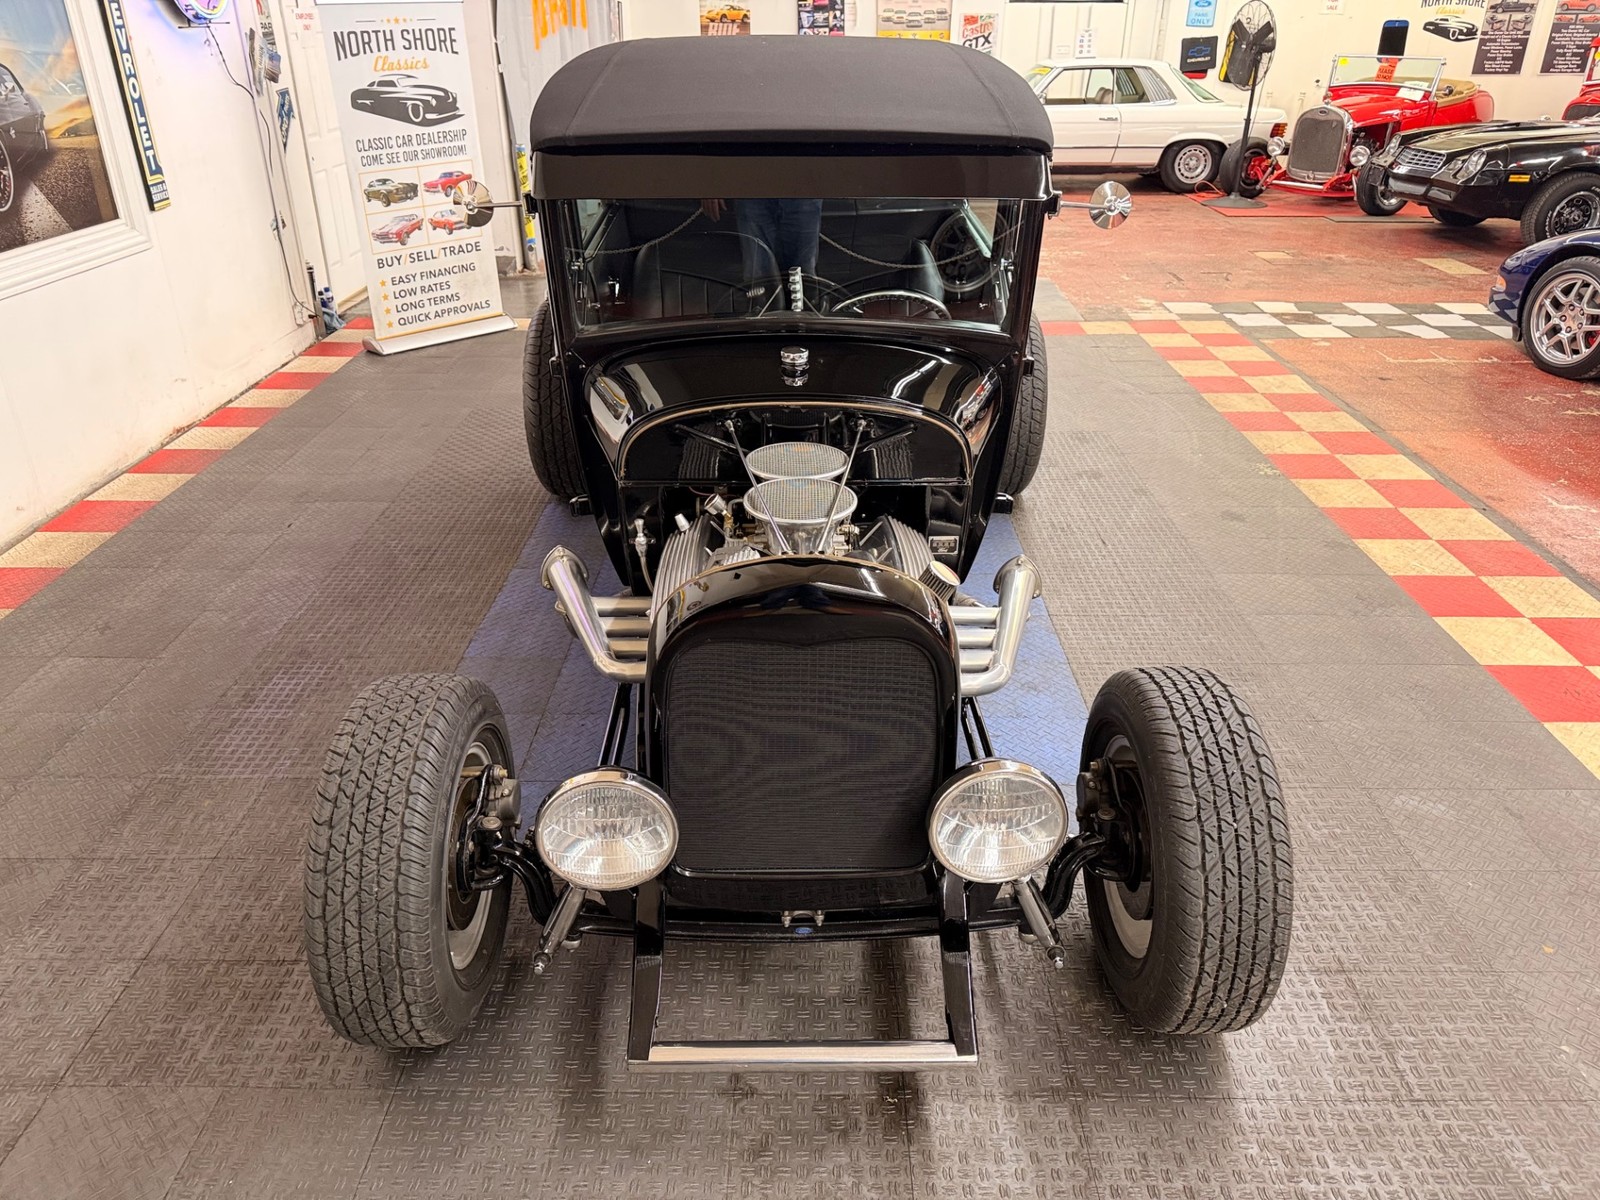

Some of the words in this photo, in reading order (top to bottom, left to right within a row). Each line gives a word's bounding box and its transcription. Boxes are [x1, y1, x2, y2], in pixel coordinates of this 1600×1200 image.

[333, 30, 396, 61] NORTH
[401, 28, 459, 55] SHORE
[963, 32, 992, 49] GTX
[374, 55, 430, 72] Classics
[356, 136, 394, 153] CLASSIC
[396, 134, 414, 148] CAR
[416, 129, 467, 146] DEALERSHIP
[361, 154, 384, 167] COME
[386, 152, 401, 163] SEE
[403, 150, 419, 162] OUR
[421, 145, 467, 160] SHOWROOM!
[391, 273, 418, 286] EASY
[420, 262, 476, 280] FINANCING
[393, 287, 418, 300] LOW
[420, 280, 451, 294] RATES
[396, 300, 425, 314] LONG
[426, 292, 461, 306] TERMS
[398, 313, 432, 326] QUICK
[434, 300, 491, 319] APPROVALS
